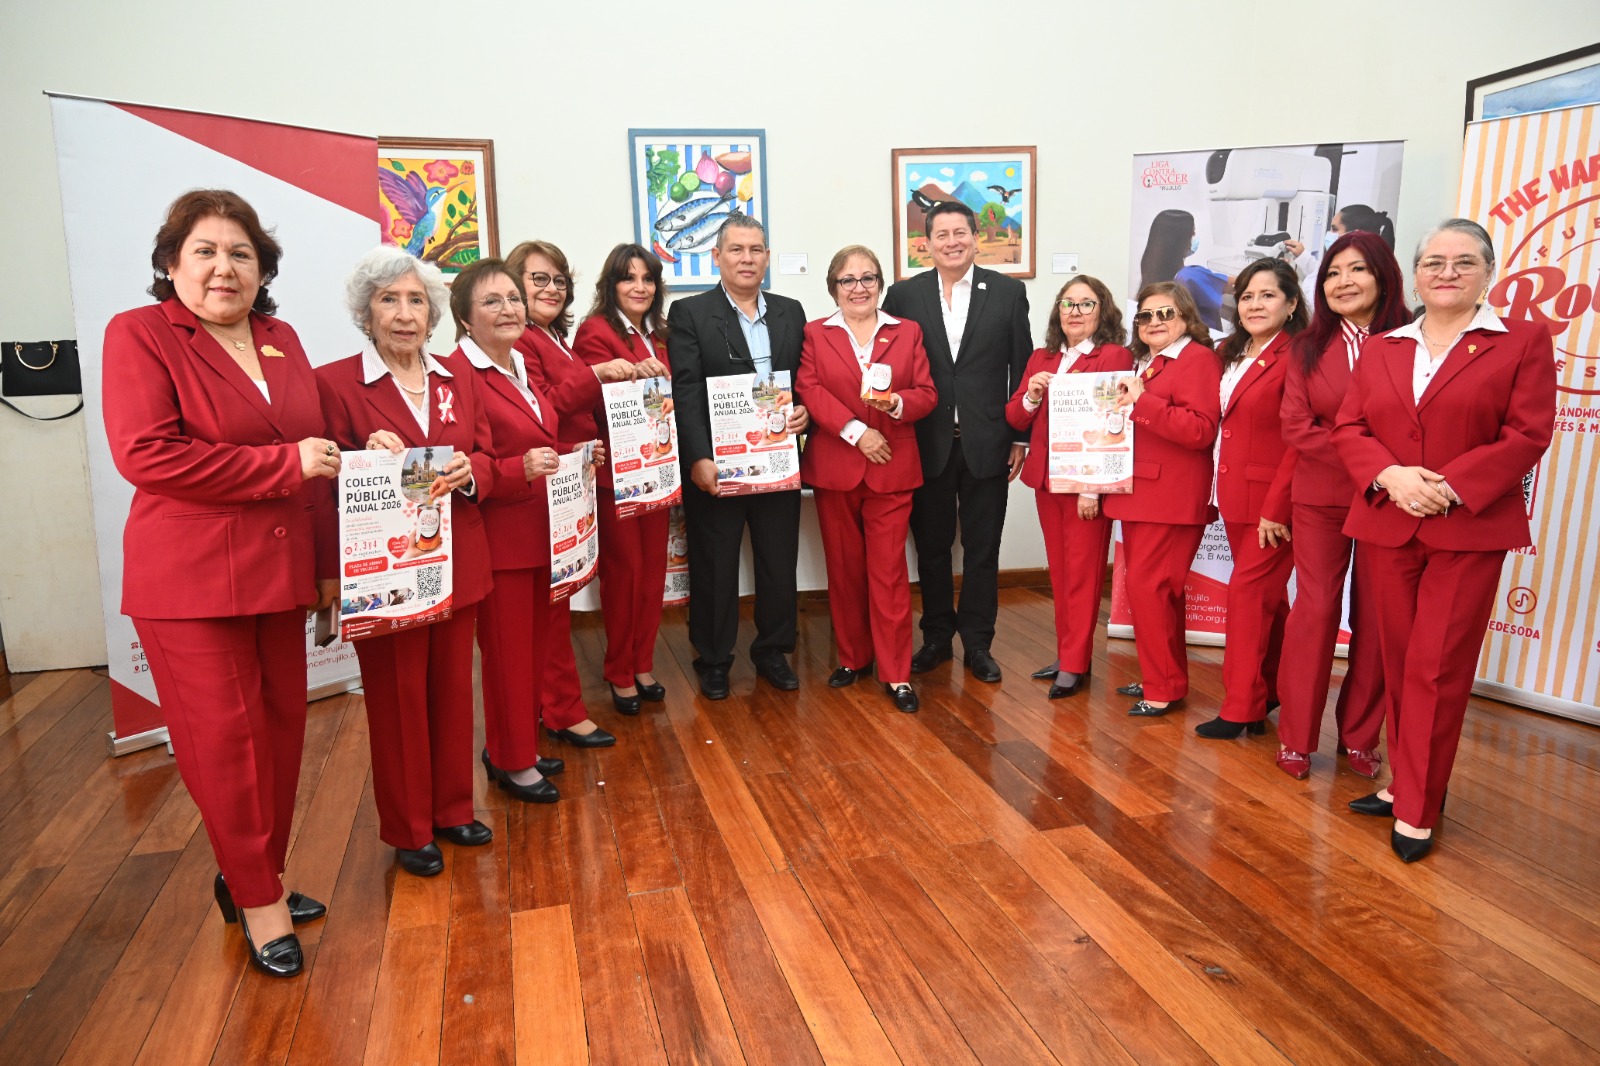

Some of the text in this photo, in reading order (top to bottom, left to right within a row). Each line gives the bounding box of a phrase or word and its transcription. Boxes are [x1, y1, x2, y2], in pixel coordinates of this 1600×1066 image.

[1488, 177, 1548, 226] THE
[1488, 266, 1600, 336] Ro
[713, 392, 744, 400] COLECTA
[610, 400, 637, 409] COLECTA
[714, 400, 749, 409] PÚBLICA
[1053, 398, 1089, 406] PÚBLICA
[611, 409, 642, 421] PÚBLICA
[1578, 423, 1586, 432] &
[346, 476, 391, 487] COLECTA
[551, 472, 578, 486] COLECTA
[553, 482, 581, 498] PÚBLICA
[346, 489, 396, 503] PÚBLICA
[553, 495, 572, 506] ANUAL
[346, 500, 401, 514] ANUAL 2026
